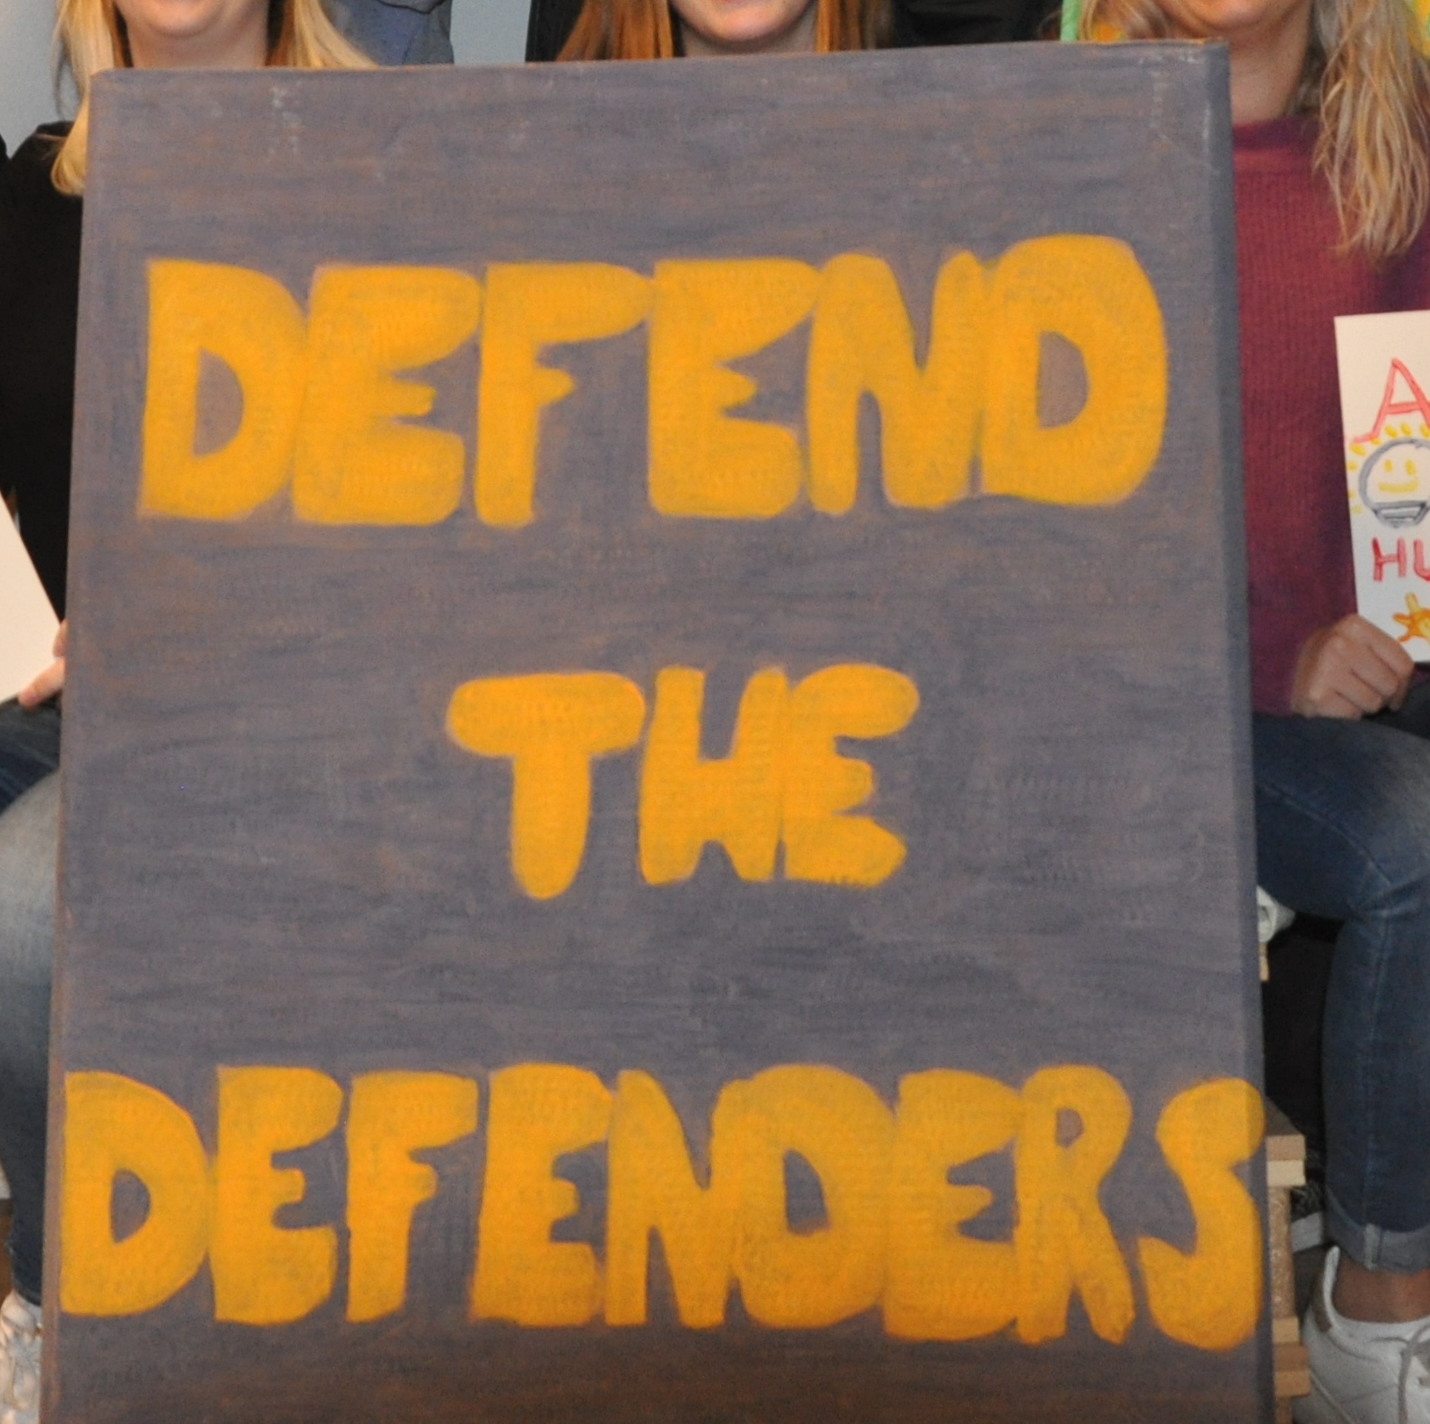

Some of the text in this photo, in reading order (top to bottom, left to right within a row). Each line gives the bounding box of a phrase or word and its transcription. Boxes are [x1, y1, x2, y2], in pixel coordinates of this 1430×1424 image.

[138, 233, 1168, 528] DEFEND
[444, 662, 921, 901] THE
[60, 1061, 1267, 1349] DEFENDERS
